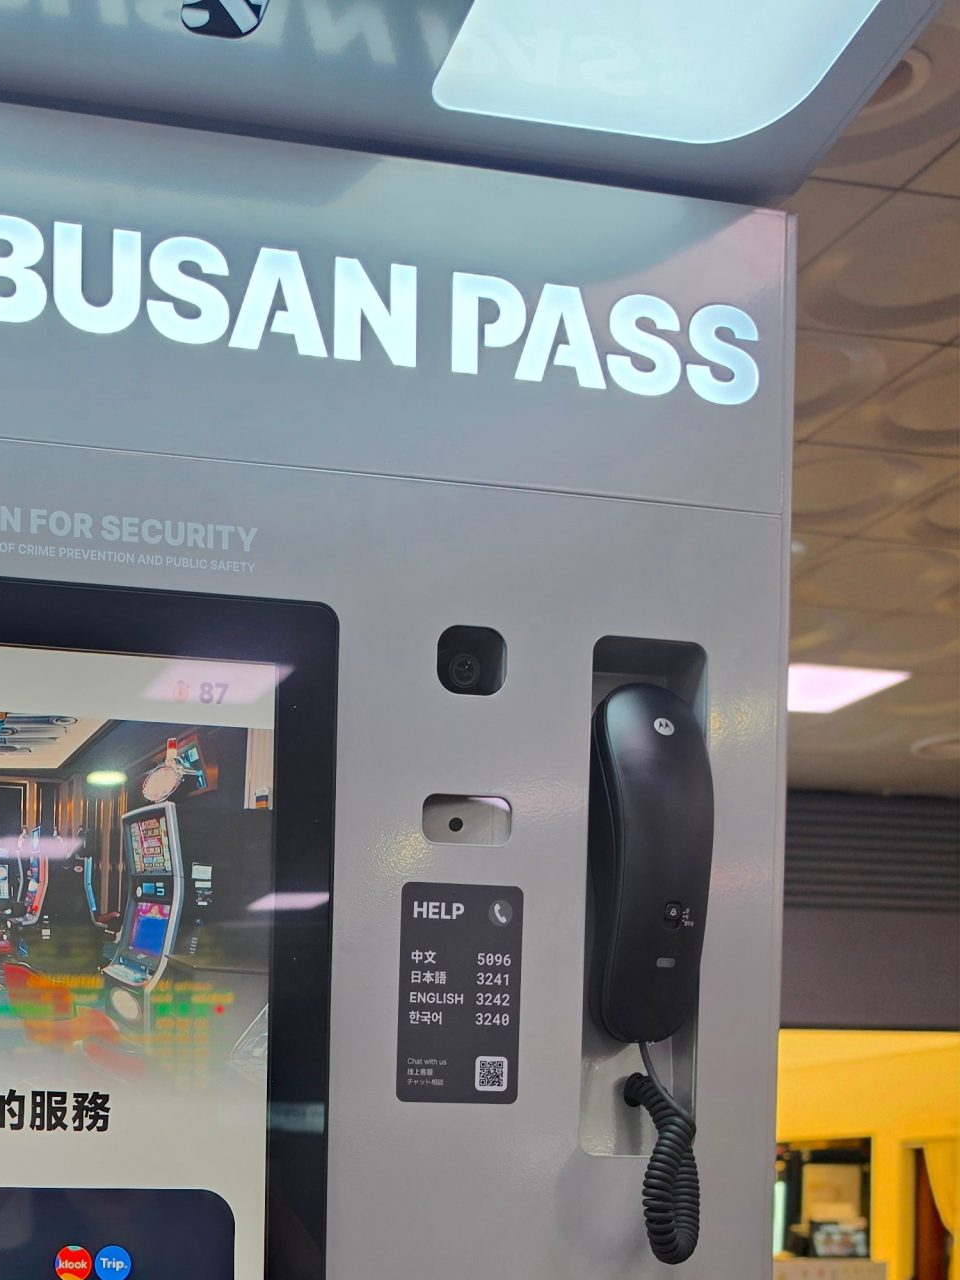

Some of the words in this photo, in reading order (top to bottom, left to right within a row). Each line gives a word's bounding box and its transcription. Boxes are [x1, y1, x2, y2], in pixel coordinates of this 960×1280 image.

[451, 271, 760, 406] PASS
[30, 508, 93, 539] FOR
[100, 515, 258, 552] SECURITY
[0, 541, 15, 554] OF
[18, 543, 56, 557] CRIME
[59, 546, 135, 564] PREVENTION
[137, 553, 163, 566] AND
[166, 556, 207, 570] PUBLIC
[210, 560, 256, 573] SAFETY
[199, 682, 229, 705] 87
[413, 901, 465, 920] HELP
[411, 950, 437, 964] 中文
[477, 953, 511, 967] 5096
[411, 971, 447, 985] 日本語
[476, 973, 509, 986] 3241
[409, 992, 464, 1005] ENGLISH
[475, 993, 510, 1006] 3242
[409, 1011, 443, 1025] 한국어
[475, 1013, 510, 1026] 3240
[407, 1057, 422, 1065] Chat
[59, 1259, 87, 1269] klook
[100, 1257, 128, 1272] Trip.
